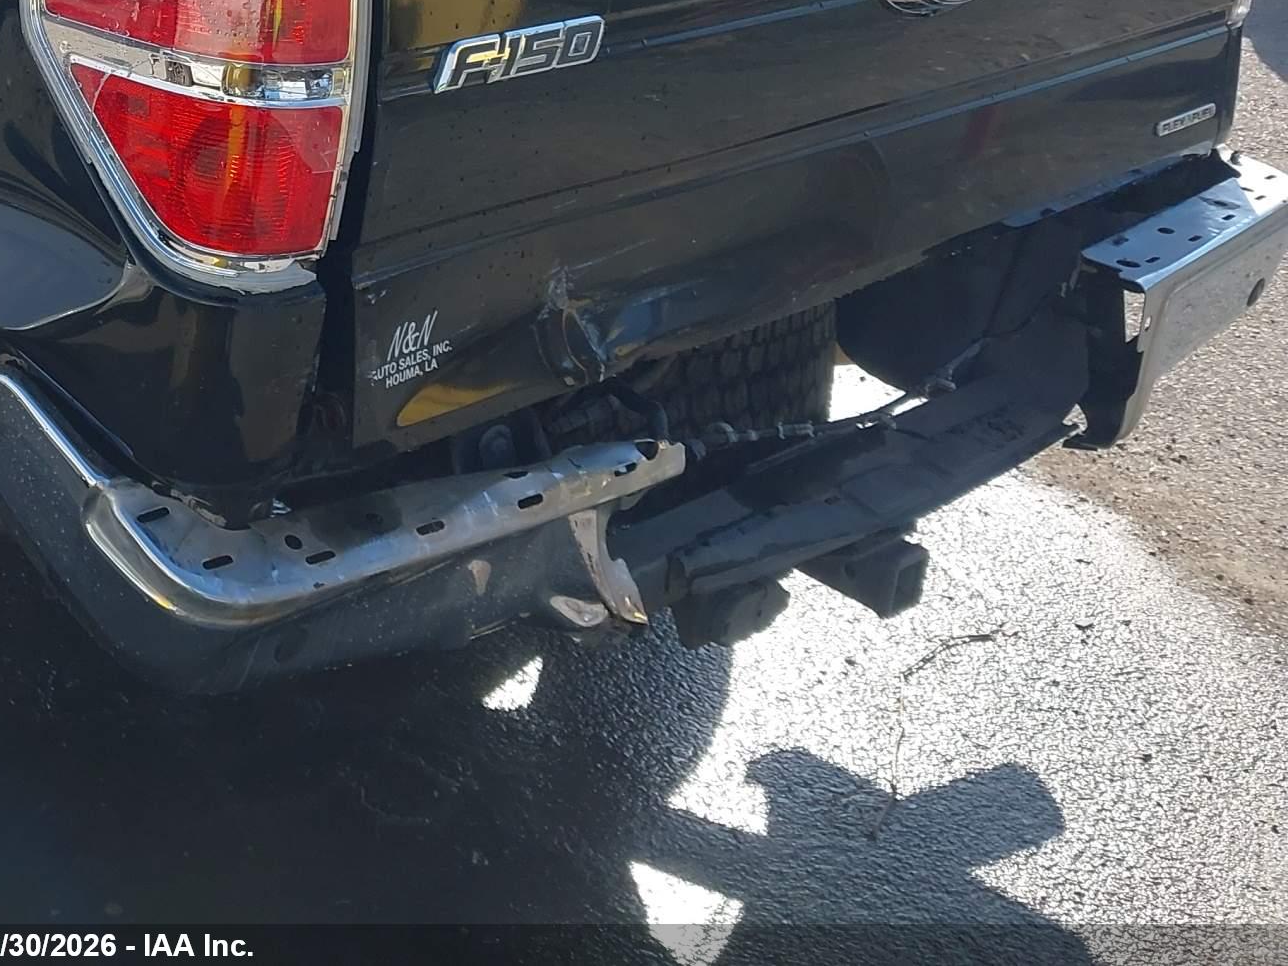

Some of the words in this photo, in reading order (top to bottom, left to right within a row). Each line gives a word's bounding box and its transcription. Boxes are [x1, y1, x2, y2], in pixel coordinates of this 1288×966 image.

[387, 309, 438, 361] N&N
[398, 348, 431, 371] SALES,
[432, 340, 453, 357] INC.
[425, 358, 438, 372] LA
